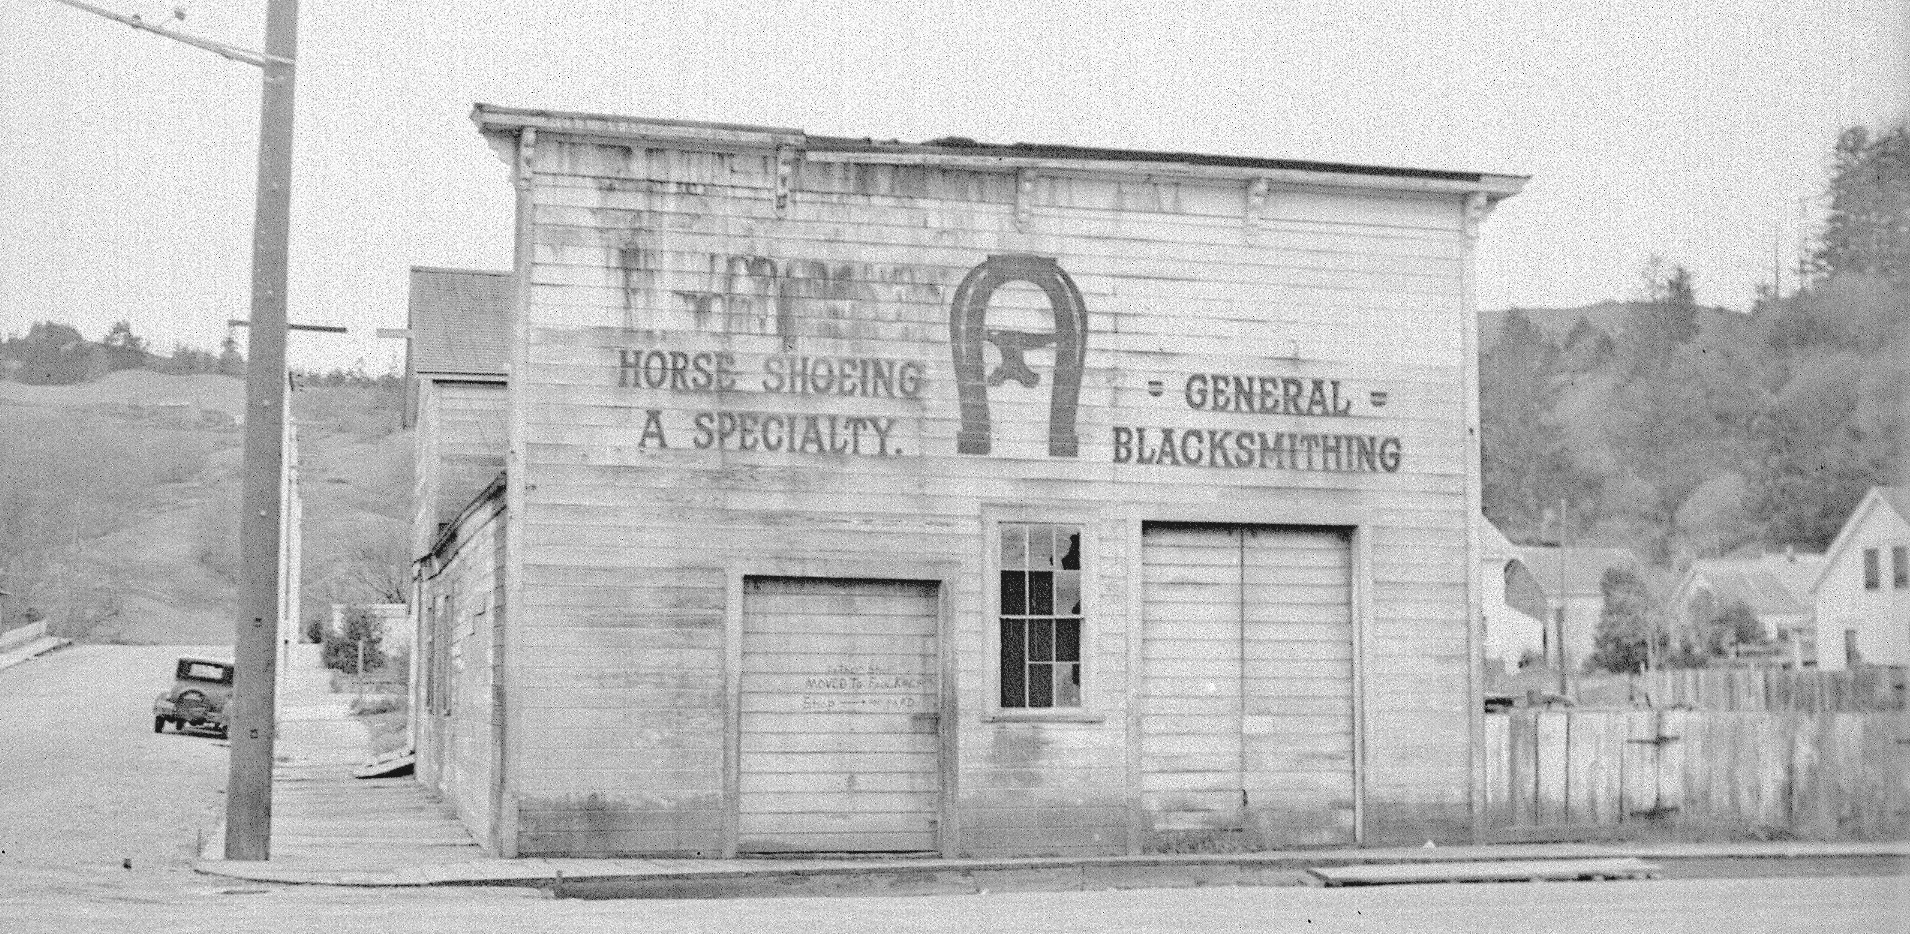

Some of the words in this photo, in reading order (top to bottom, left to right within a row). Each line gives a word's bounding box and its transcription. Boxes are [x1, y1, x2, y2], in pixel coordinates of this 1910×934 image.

[618, 350, 737, 389] HORSE
[762, 357, 924, 397] SHOEING
[1185, 373, 1350, 416] GENERAL
[639, 410, 669, 450] A
[693, 413, 902, 454] SPECIALTY.
[1112, 425, 1401, 472] BLACKSMITHING
[805, 677, 847, 689] MOVED
